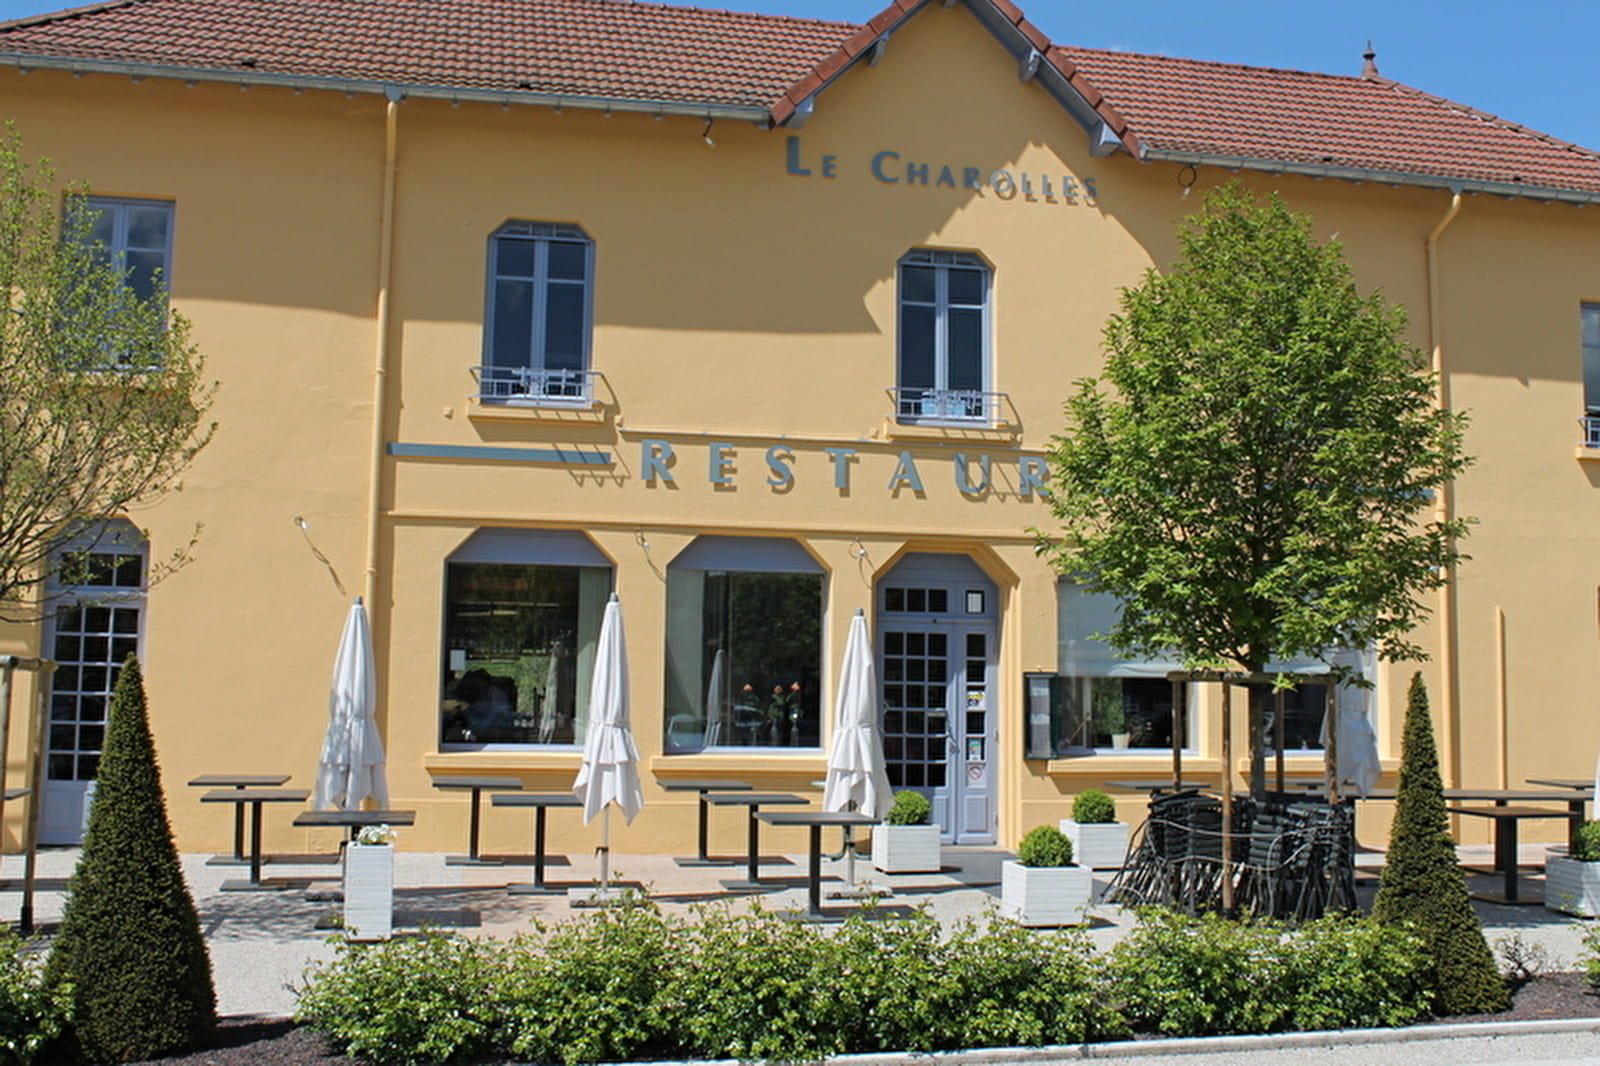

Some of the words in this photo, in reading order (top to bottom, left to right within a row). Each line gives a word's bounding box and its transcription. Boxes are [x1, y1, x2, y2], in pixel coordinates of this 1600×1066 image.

[786, 136, 837, 177] LE
[871, 151, 1098, 201] CHAROLLES
[641, 439, 1052, 497] RESTAUR
